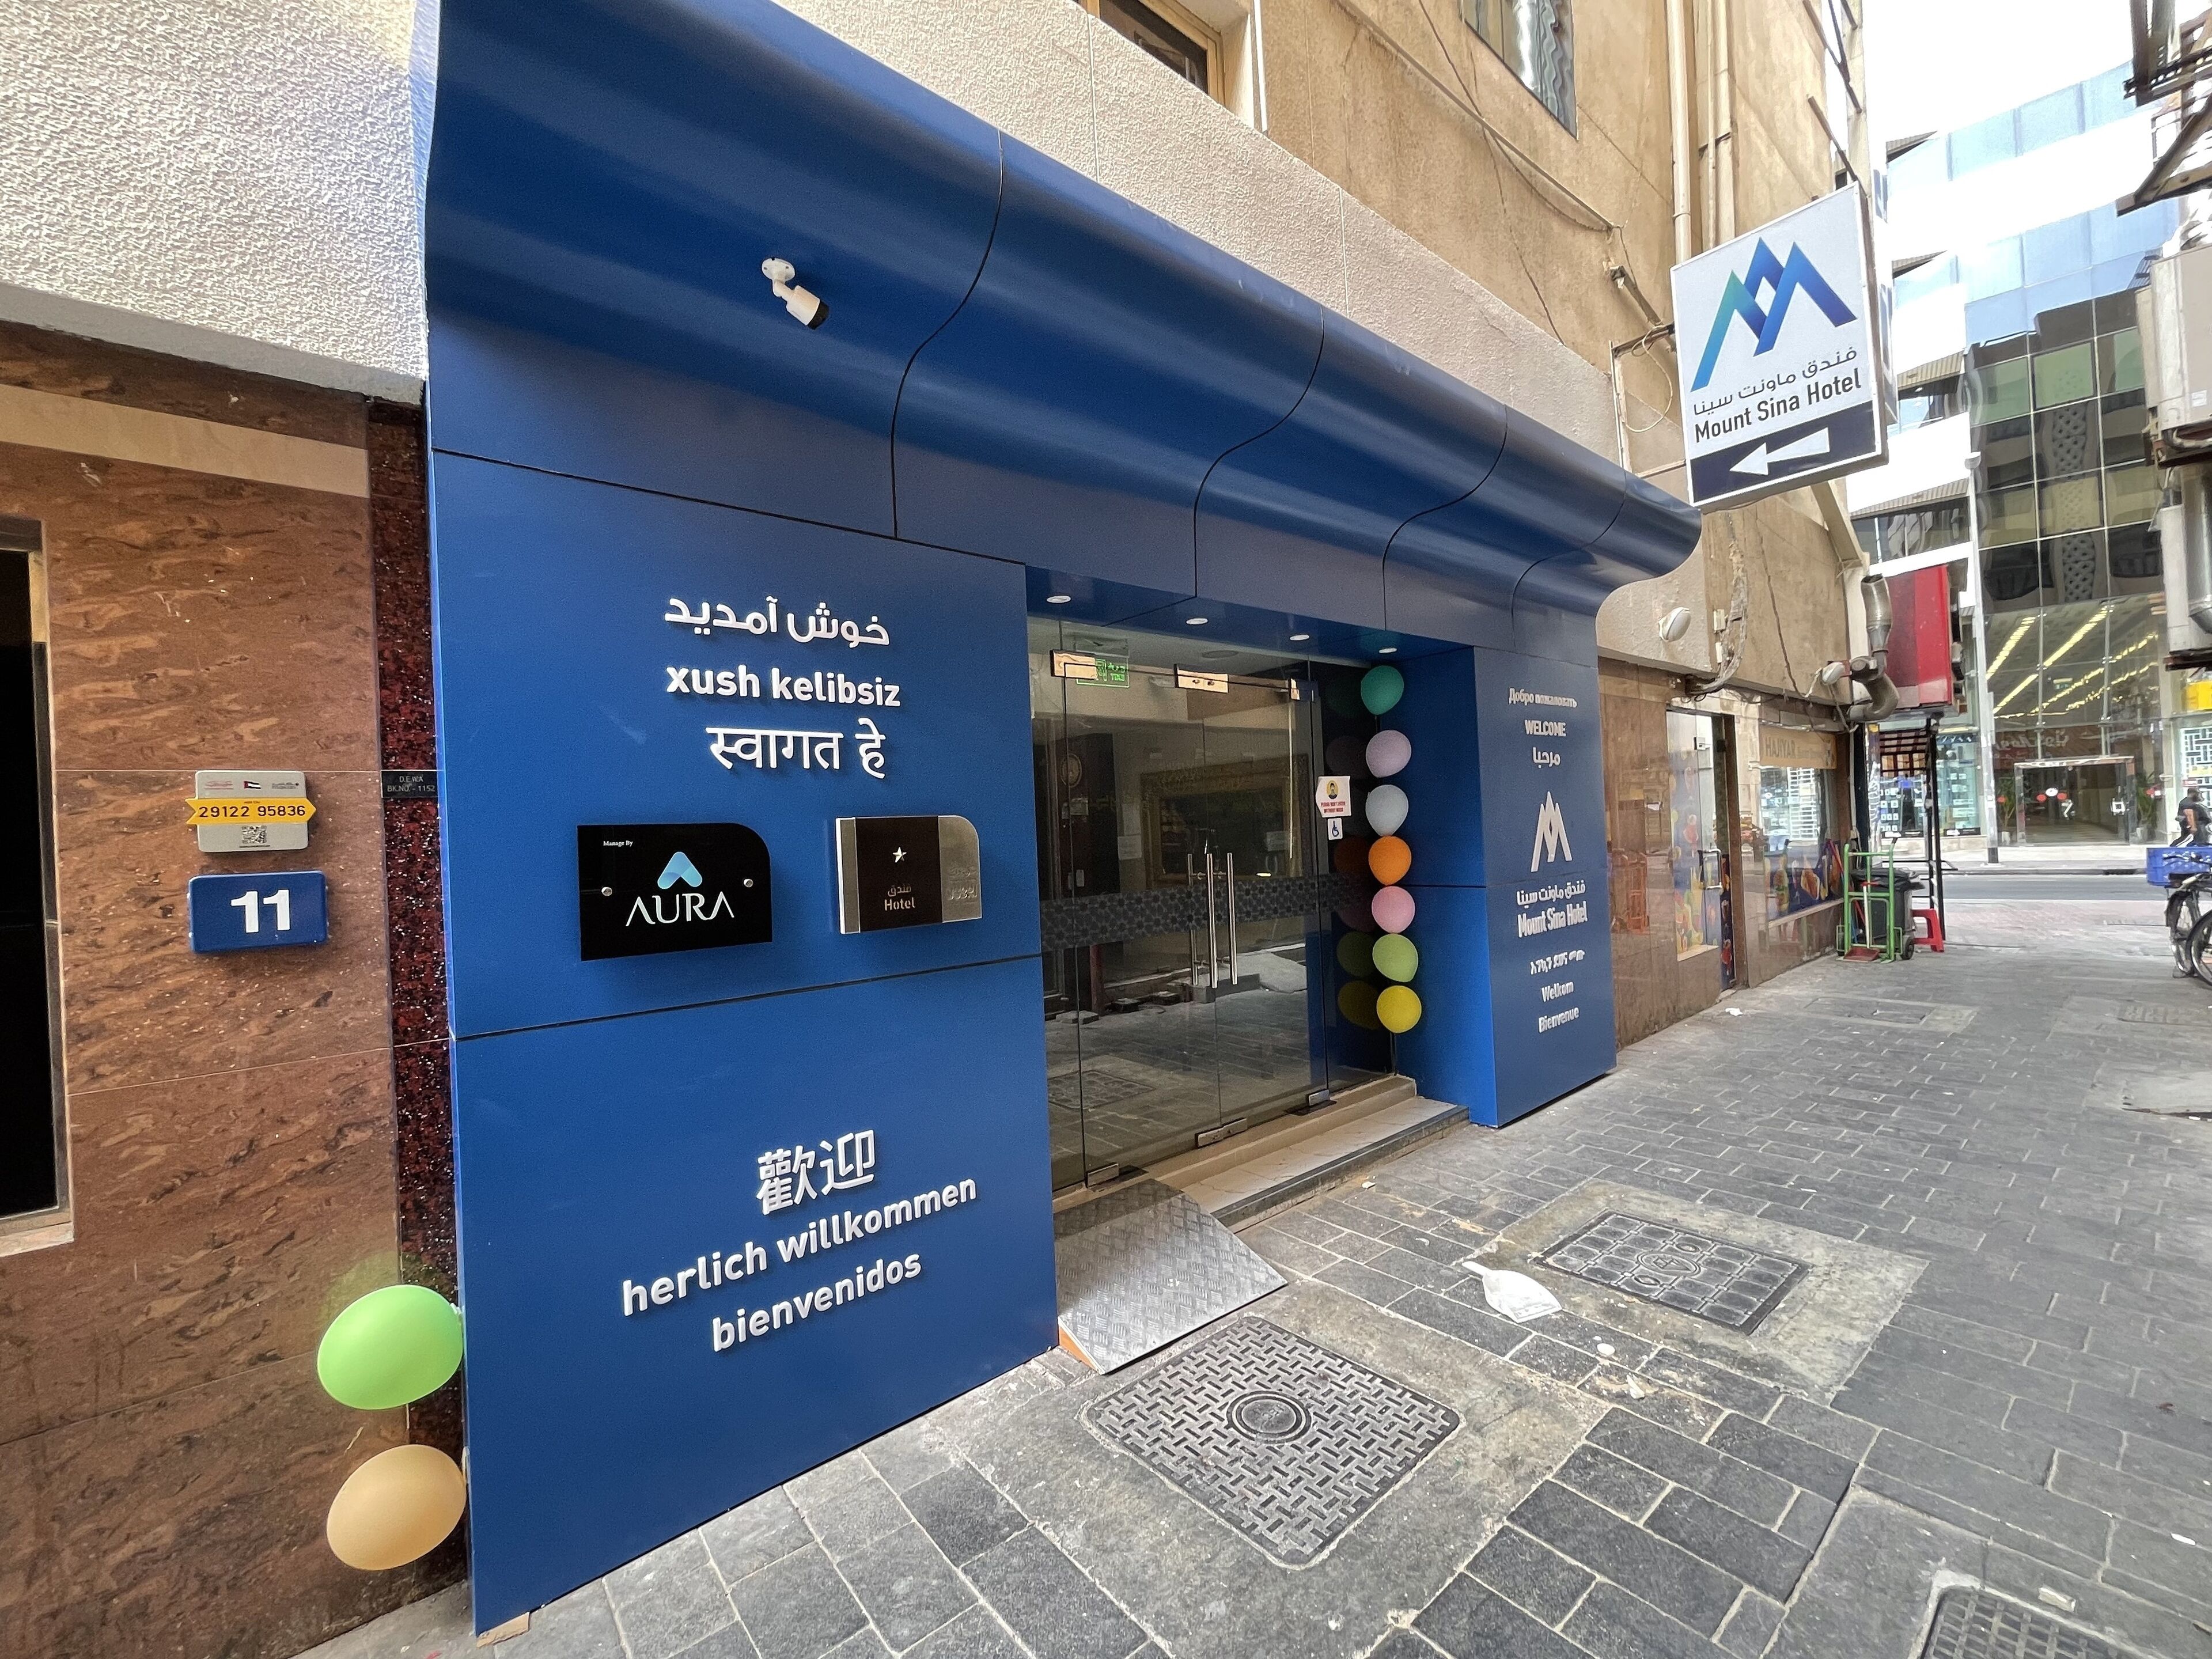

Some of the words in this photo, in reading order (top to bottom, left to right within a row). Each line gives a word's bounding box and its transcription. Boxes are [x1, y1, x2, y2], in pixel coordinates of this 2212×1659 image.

[1802, 346, 1857, 378] فندق
[1738, 373, 1796, 399] ماونت
[1694, 394, 1733, 415] سينا
[1695, 407, 1752, 443] Mount
[1757, 395, 1800, 421] Sina
[1807, 368, 1862, 406] Hotel
[664, 596, 779, 635] آمديد
[787, 602, 890, 648] خوش
[666, 665, 761, 698] xush
[771, 667, 902, 707] kelibsiz
[1509, 688, 1535, 706] Добро
[1524, 719, 1566, 737] WELCOME
[705, 726, 844, 770] स्वागत
[1532, 747, 1561, 768] مرحبا
[199, 806, 250, 817] 29122
[257, 805, 305, 817] 95836
[887, 883, 912, 897] فندق
[1517, 890, 1538, 909] سينا
[1538, 884, 1564, 902] ماونت
[1564, 880, 1586, 899] فندق
[230, 889, 291, 934] 11
[625, 891, 735, 927] AURA
[884, 896, 916, 911] Hotel
[1517, 911, 1547, 938] Mount
[1547, 907, 1566, 930] Sina
[1566, 900, 1588, 926] Hotel
[1541, 981, 1574, 1002] Welkom
[1538, 1007, 1580, 1033] Bienvenue
[756, 1129, 876, 1215] 歡迎
[622, 1241, 768, 1317] herlich
[776, 1178, 977, 1263] willkommen
[711, 1253, 922, 1353] bienvenidos
